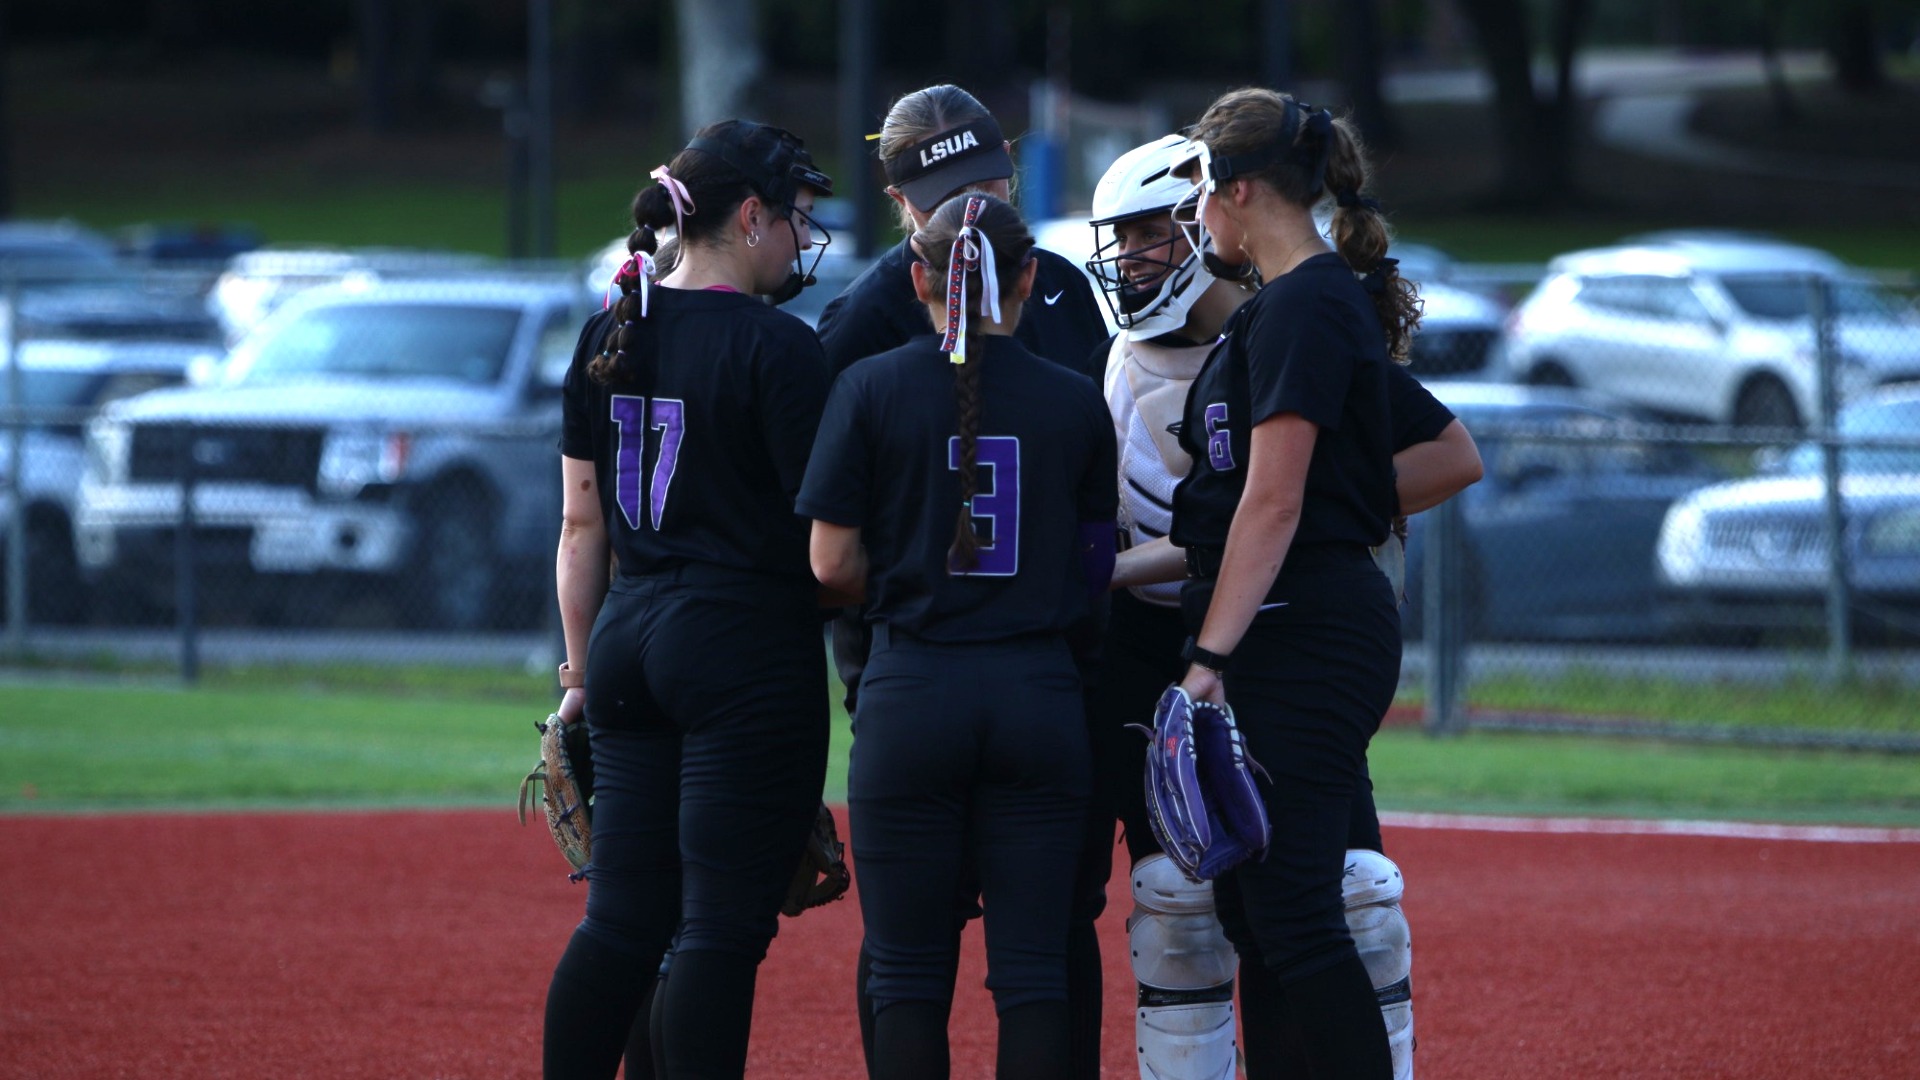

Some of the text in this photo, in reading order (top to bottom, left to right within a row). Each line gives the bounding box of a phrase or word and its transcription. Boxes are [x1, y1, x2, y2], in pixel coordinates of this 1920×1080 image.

[919, 130, 980, 168] LSUA
[610, 394, 686, 532] 17
[1204, 402, 1237, 472] 6
[947, 435, 1020, 577] 3
